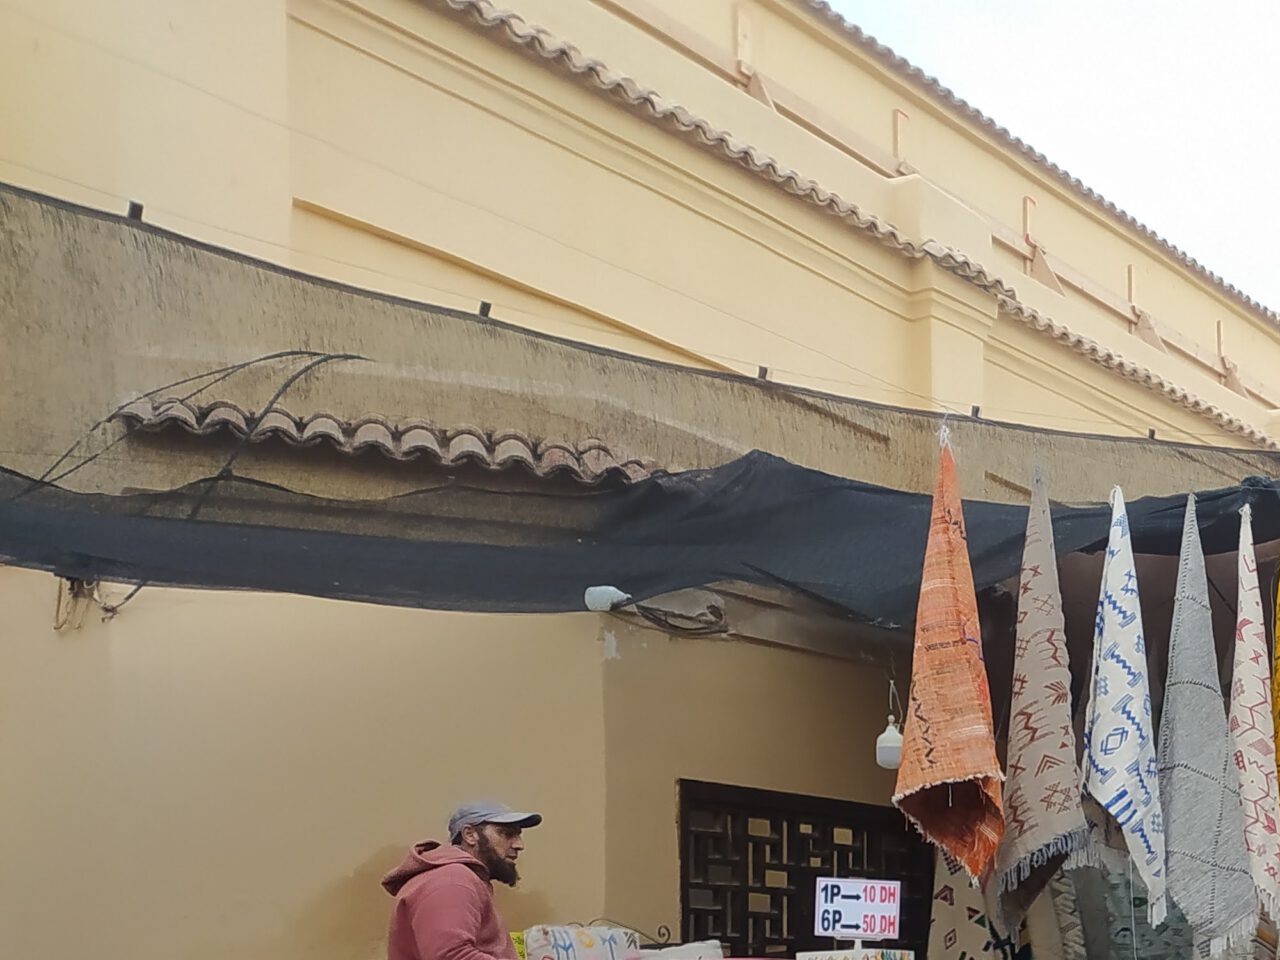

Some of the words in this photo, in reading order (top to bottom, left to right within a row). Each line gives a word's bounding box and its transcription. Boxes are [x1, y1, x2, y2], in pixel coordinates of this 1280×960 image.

[821, 883, 842, 904] 1P
[862, 885, 876, 903] 10
[880, 886, 896, 904] DH
[821, 909, 843, 932] 6P
[862, 914, 876, 933] 50
[880, 915, 896, 934] DH
